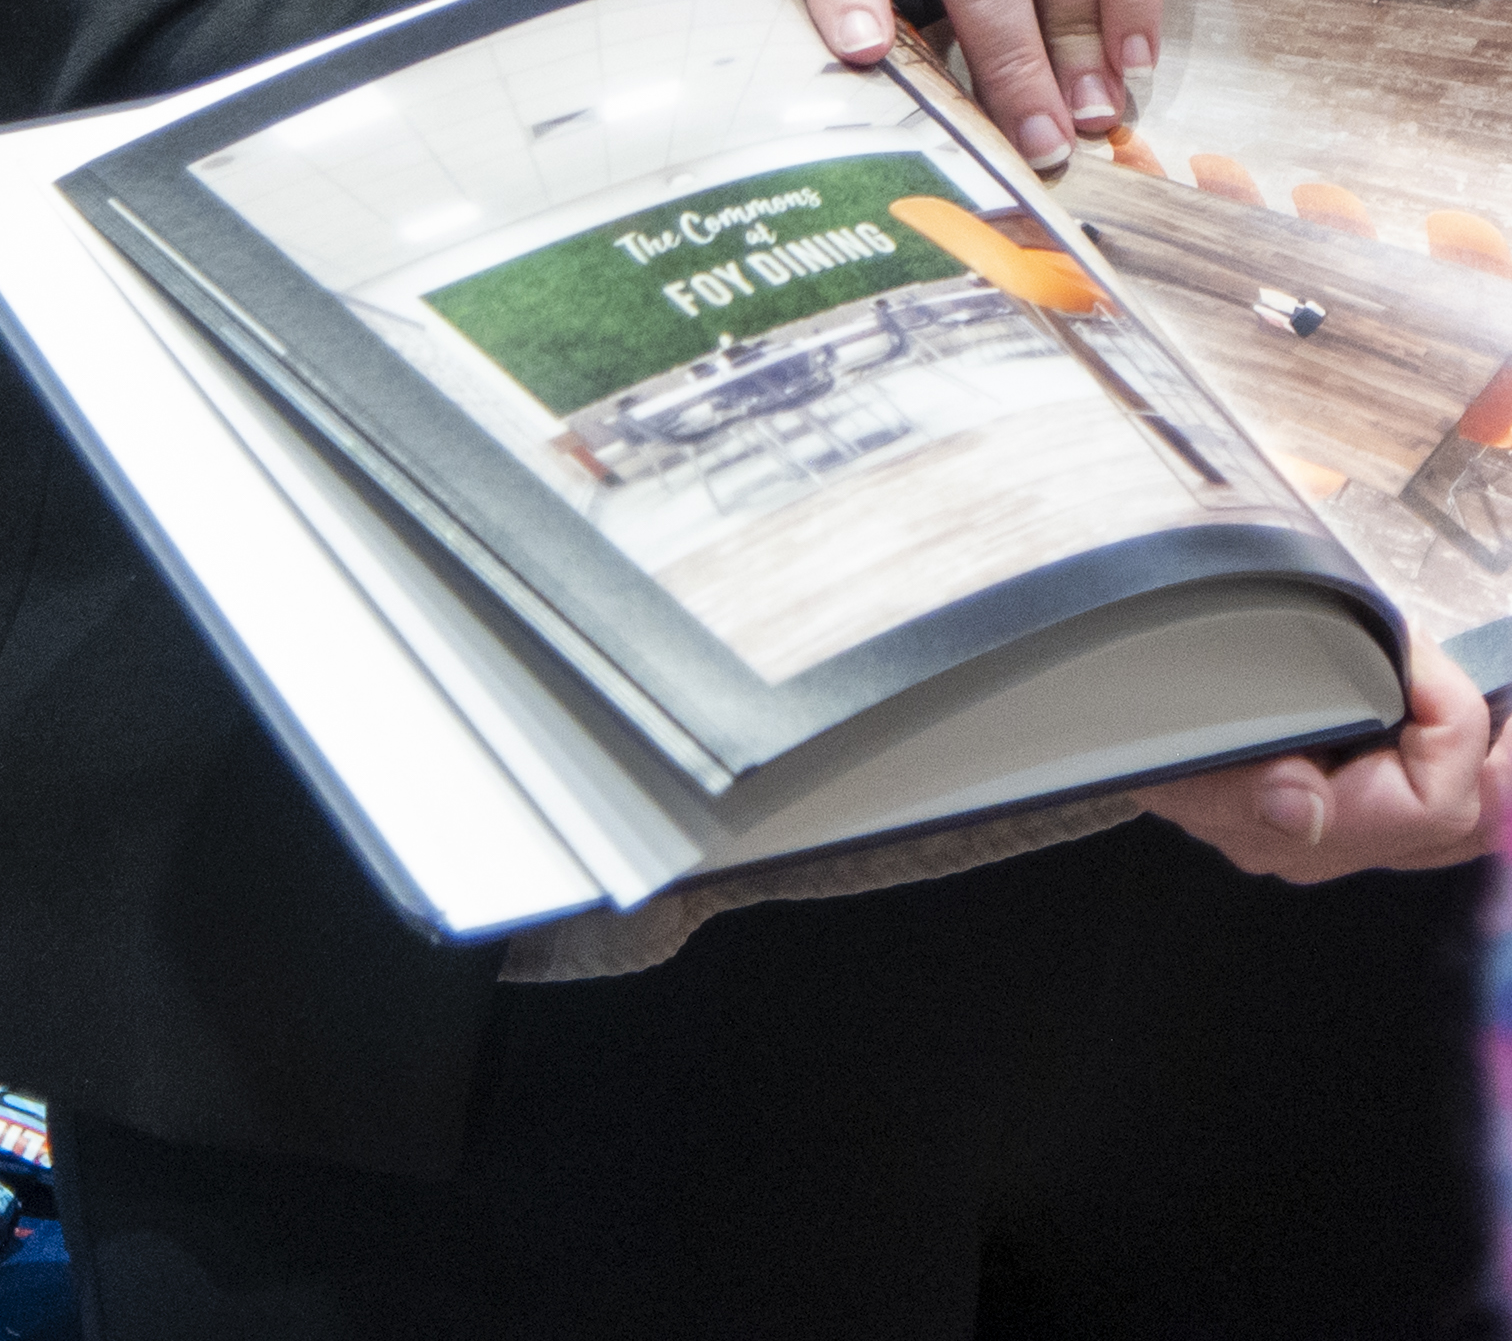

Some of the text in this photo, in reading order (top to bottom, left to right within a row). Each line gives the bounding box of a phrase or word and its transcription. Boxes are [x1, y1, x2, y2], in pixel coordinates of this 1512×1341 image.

[613, 186, 822, 265] The Commons
[745, 221, 778, 247] at
[662, 221, 897, 318] FOY DINING
